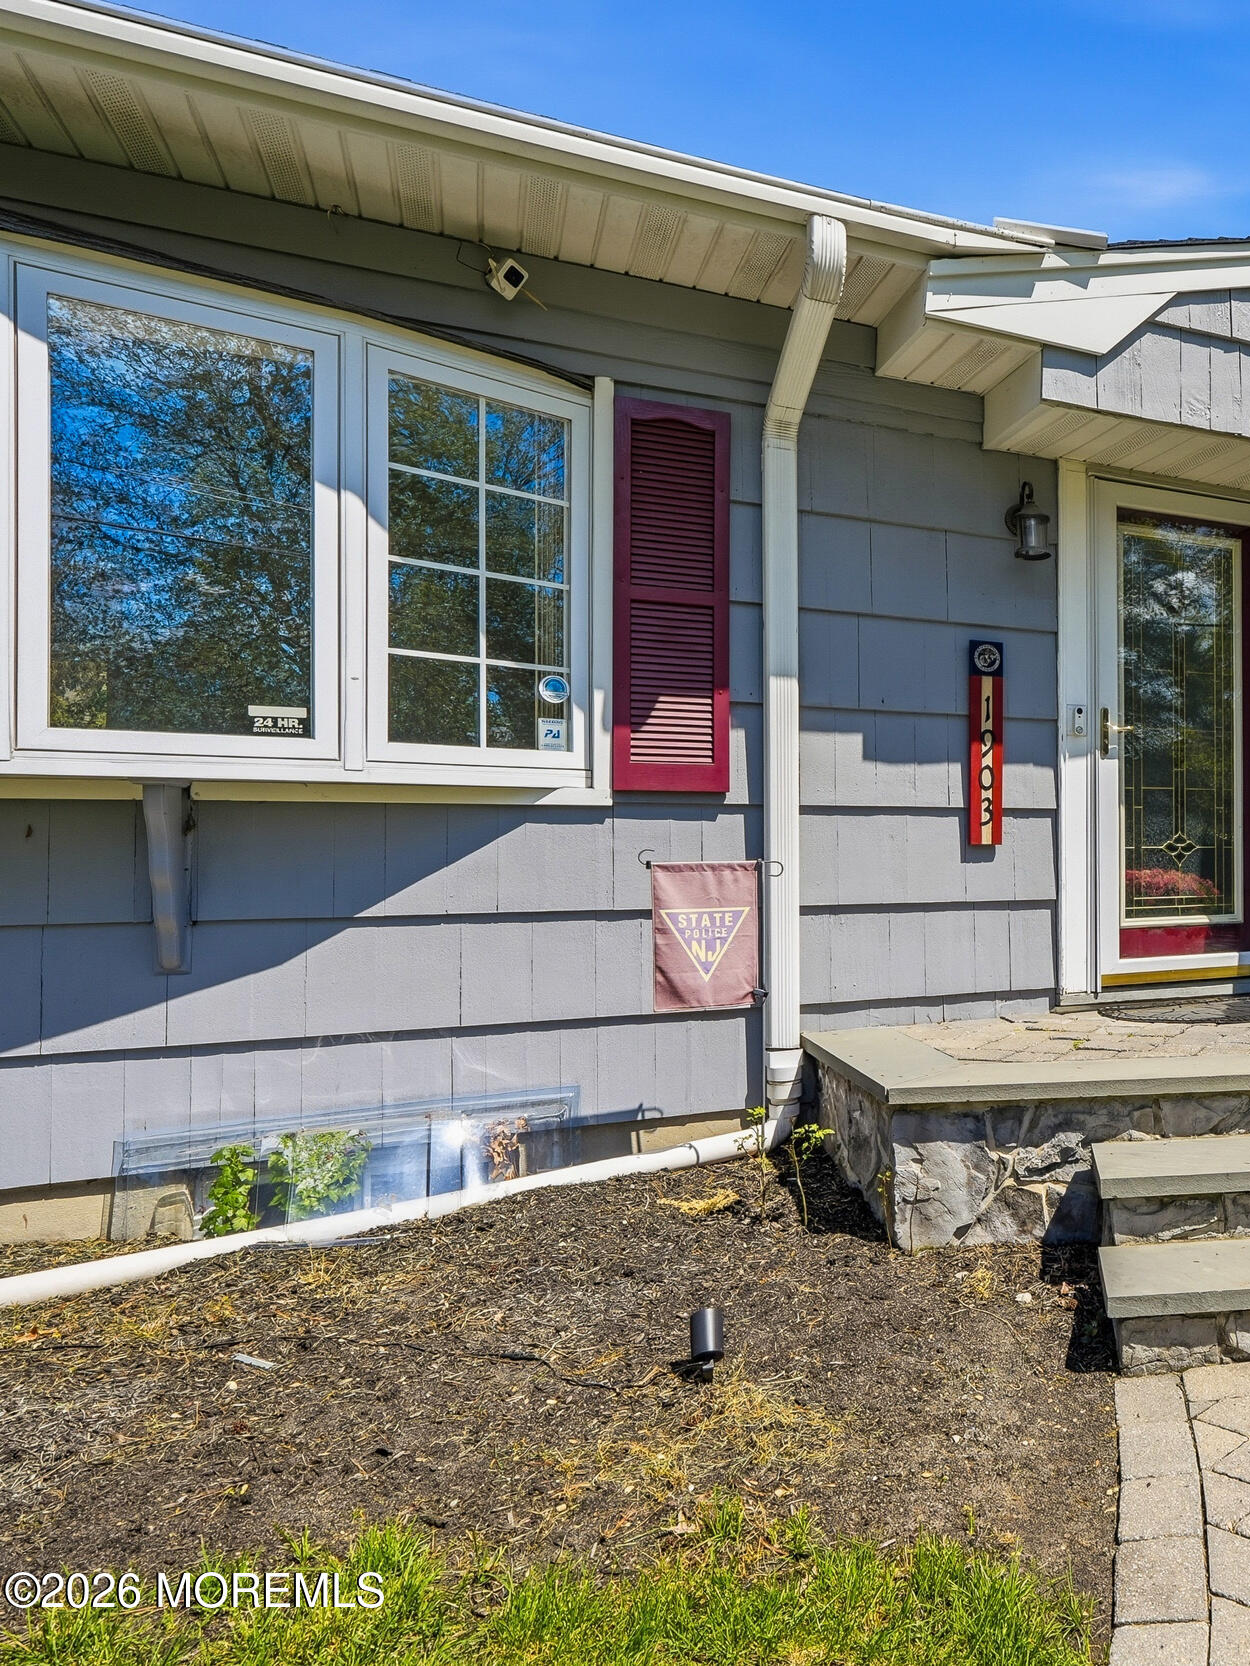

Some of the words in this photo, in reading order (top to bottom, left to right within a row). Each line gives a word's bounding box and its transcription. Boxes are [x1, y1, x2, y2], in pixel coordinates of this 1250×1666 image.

[254, 717, 274, 727] 24
[277, 717, 303, 728] HR.
[978, 696, 995, 826] 1903
[678, 912, 734, 929] STATE
[685, 927, 728, 939] POLICE
[691, 938, 721, 963] NJ
